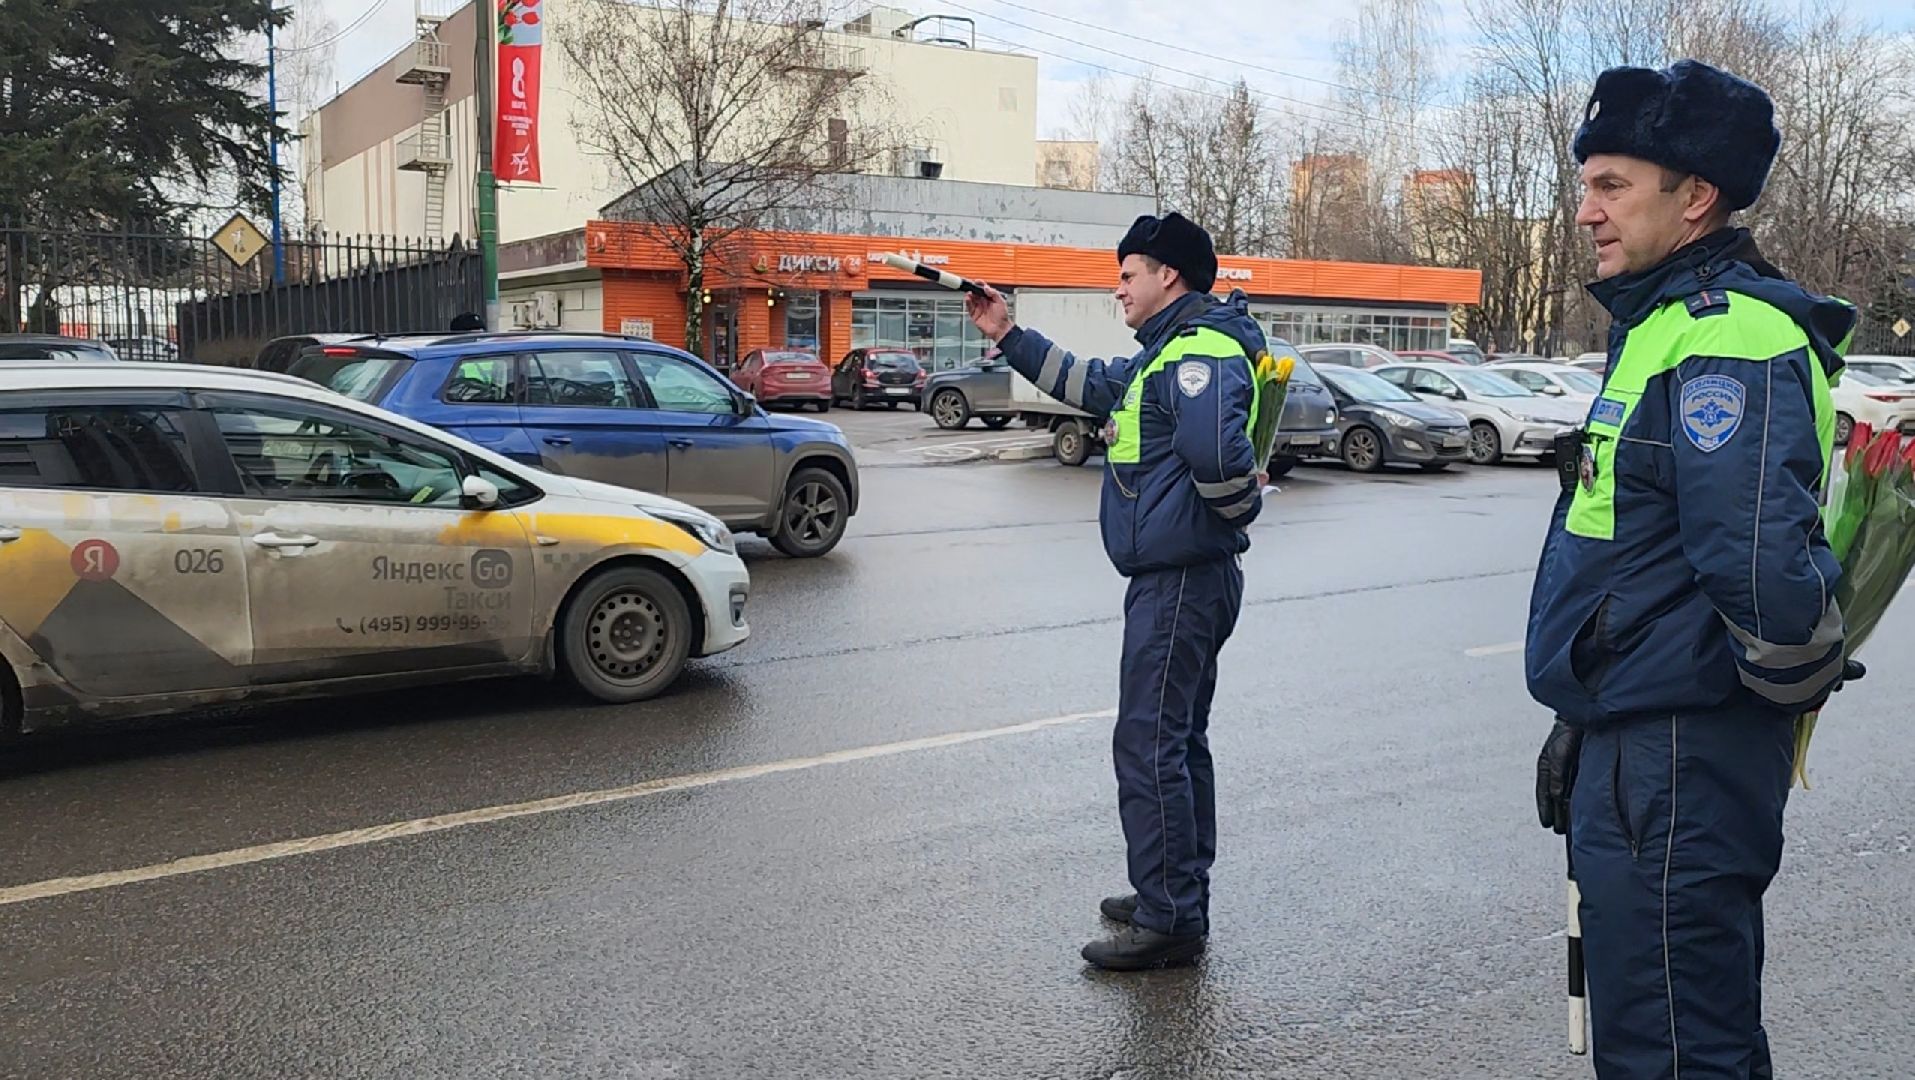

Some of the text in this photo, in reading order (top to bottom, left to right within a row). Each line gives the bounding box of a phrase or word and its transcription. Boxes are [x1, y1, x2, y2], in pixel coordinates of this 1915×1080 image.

[512, 57, 526, 99] 8
[778, 254, 840, 272] ДИКСИ
[1691, 390, 1734, 404] РОССИЯ
[83, 546, 104, 573] Я
[174, 549, 225, 574] 026
[371, 555, 509, 583] Яндекс Go
[444, 586, 512, 610] Такси
[360, 616, 410, 635] (495)
